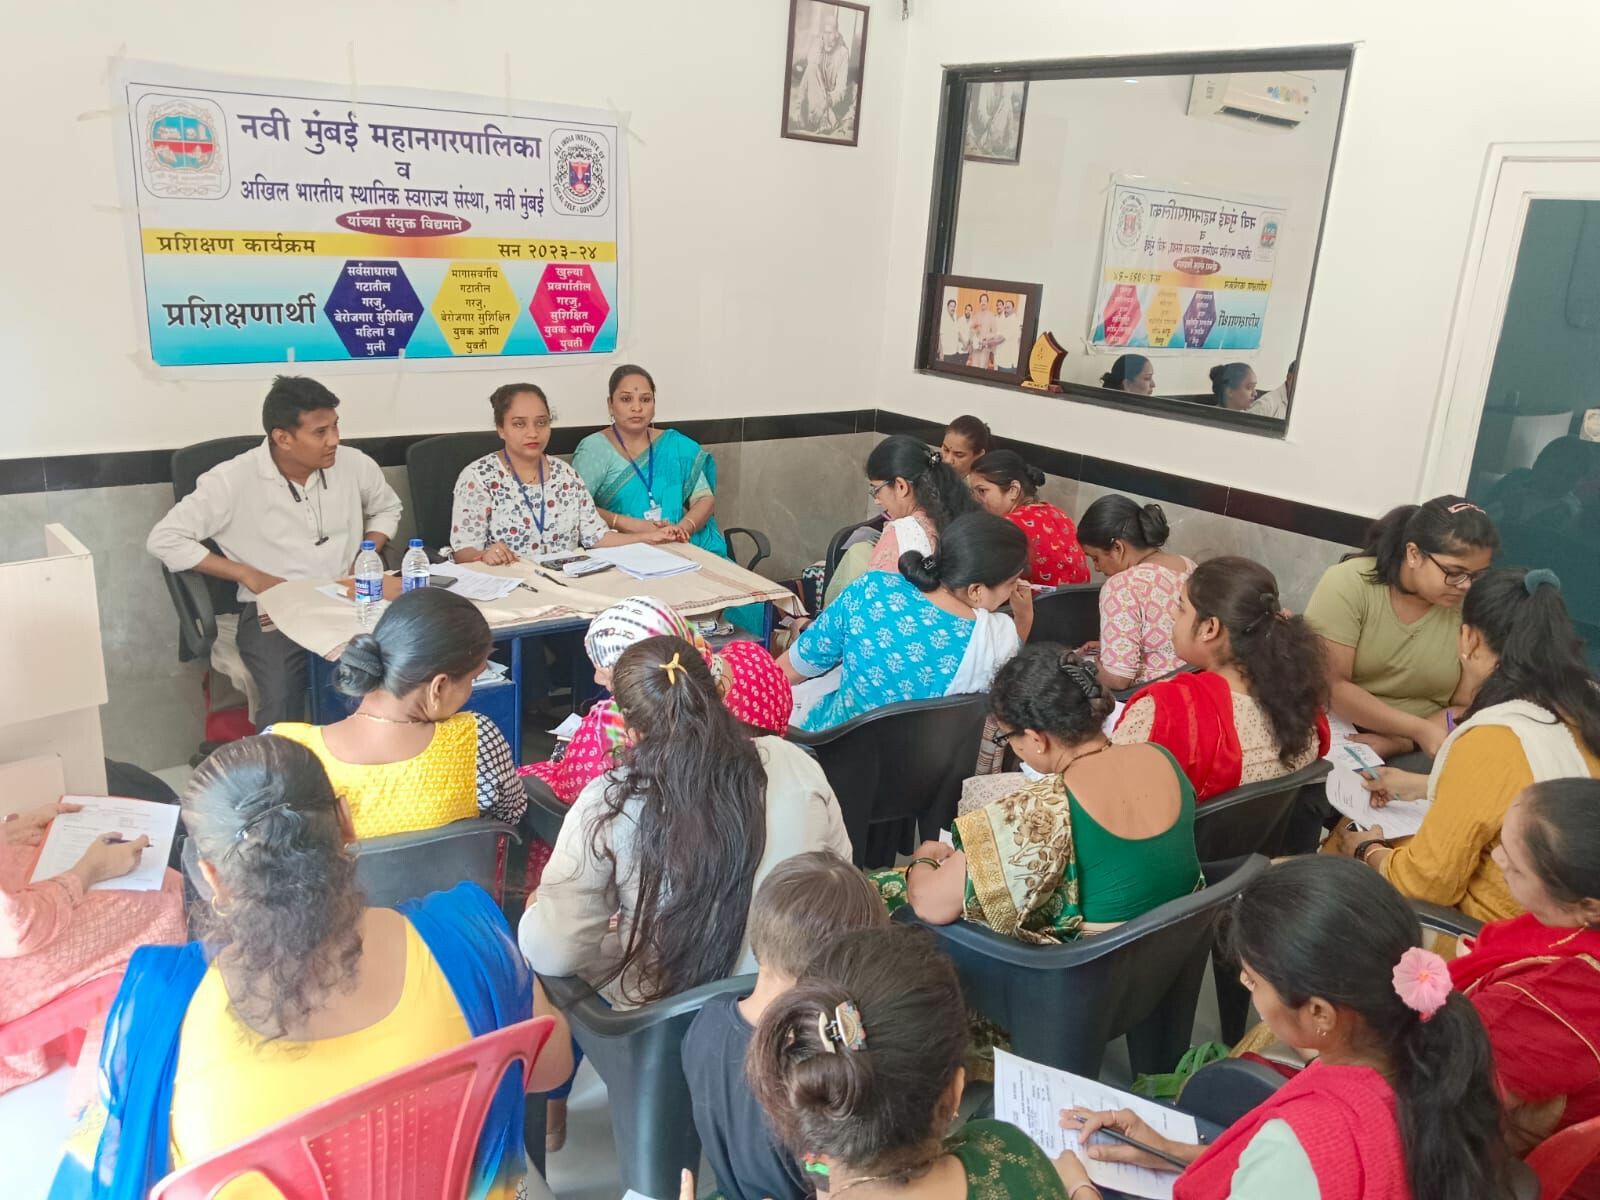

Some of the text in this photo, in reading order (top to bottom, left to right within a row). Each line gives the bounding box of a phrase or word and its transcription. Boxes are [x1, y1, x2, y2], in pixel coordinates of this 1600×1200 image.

[237, 107, 290, 141] नवी
[301, 109, 359, 155] मुंबई
[368, 122, 543, 159] महानगरपालिका
[395, 161, 411, 180] व
[241, 173, 289, 201] अखिल
[296, 177, 343, 203] भारतीय
[349, 179, 400, 205] स्थानिक
[404, 188, 448, 208] स्वराज्य
[453, 184, 489, 213] संस्था,
[494, 188, 515, 211] नवी
[520, 188, 545, 219] मुंबई
[347, 212, 463, 233] यांच्या संयुक्त विद्यमाने
[156, 232, 315, 254] प्रशिक्षण कार्यक्रम
[498, 244, 598, 259] सन २०२३-२४
[347, 263, 398, 277] सर्वसाधारण
[355, 280, 391, 292] गटातील
[460, 282, 491, 293] गटातील
[162, 292, 317, 329] प्रशिक्षणार्थी
[333, 309, 414, 326] बेरोजगार सुशिक्षित
[355, 325, 396, 338] महिला व
[478, 325, 500, 336] आणि
[366, 339, 386, 356] मुली
